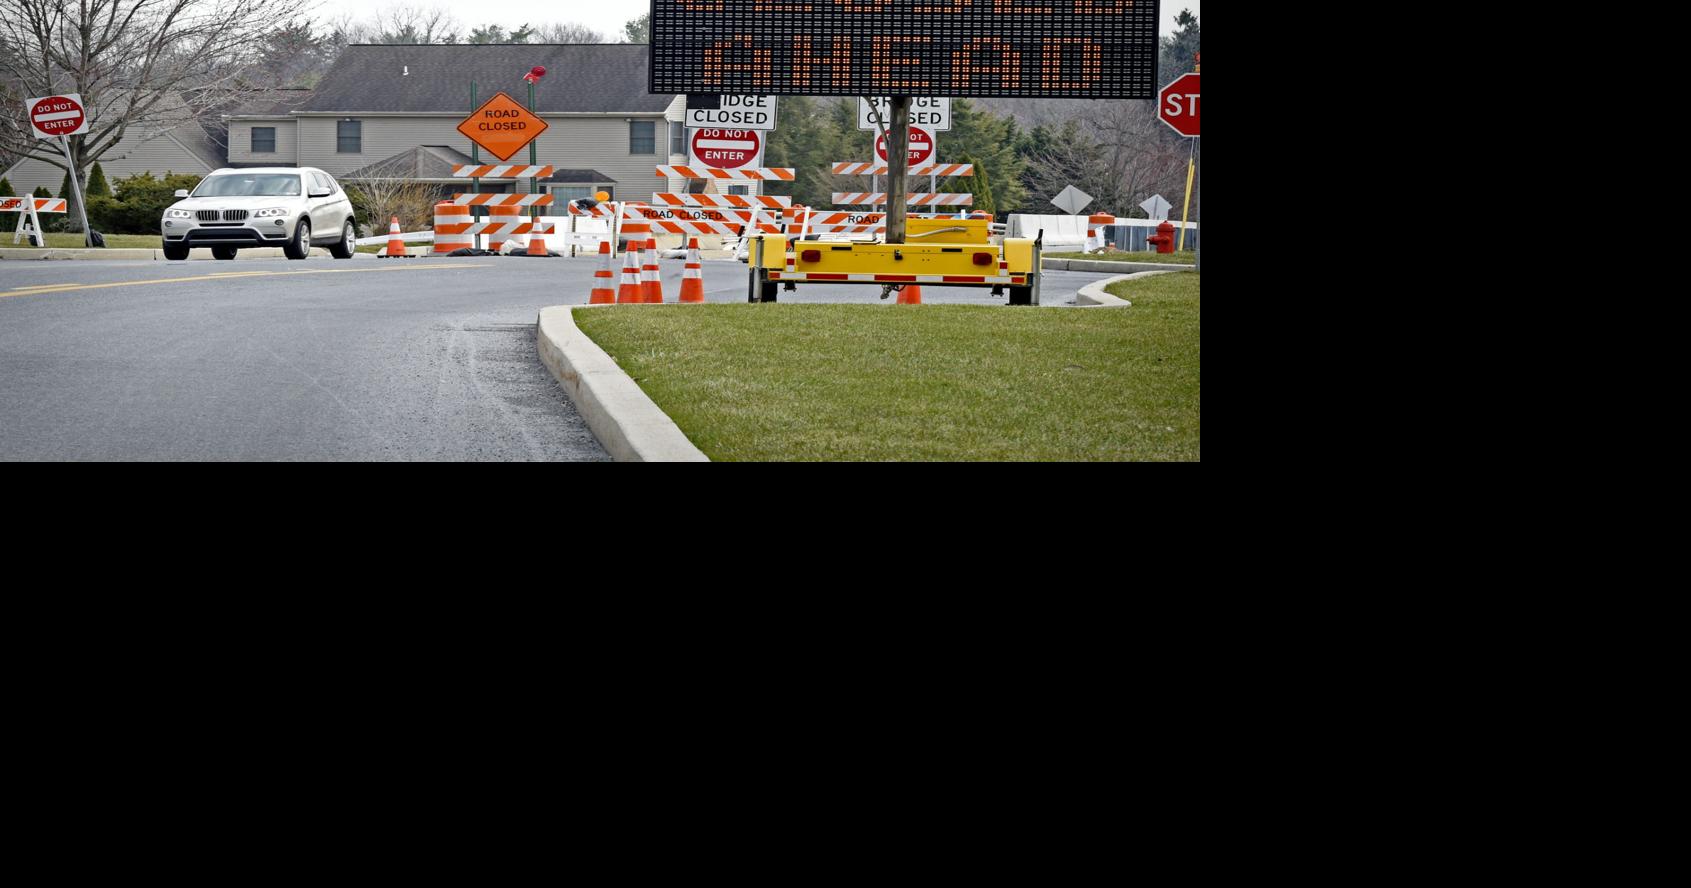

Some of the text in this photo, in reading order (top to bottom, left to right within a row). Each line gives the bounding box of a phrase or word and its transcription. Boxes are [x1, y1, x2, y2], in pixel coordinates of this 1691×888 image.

[704, 35, 1101, 88] AHEAD
[53, 102, 72, 111] NOT
[723, 95, 767, 108] IDGE
[485, 109, 520, 118] ROAD
[693, 109, 768, 125] CLOSED
[866, 111, 942, 125] CLSED
[44, 120, 76, 130] ENTER
[478, 121, 527, 131] CLOSED
[703, 129, 750, 139] DO NOT
[705, 150, 745, 160] ENTER
[643, 209, 723, 220] ROAD CLOSED
[847, 215, 880, 224] ROAD
